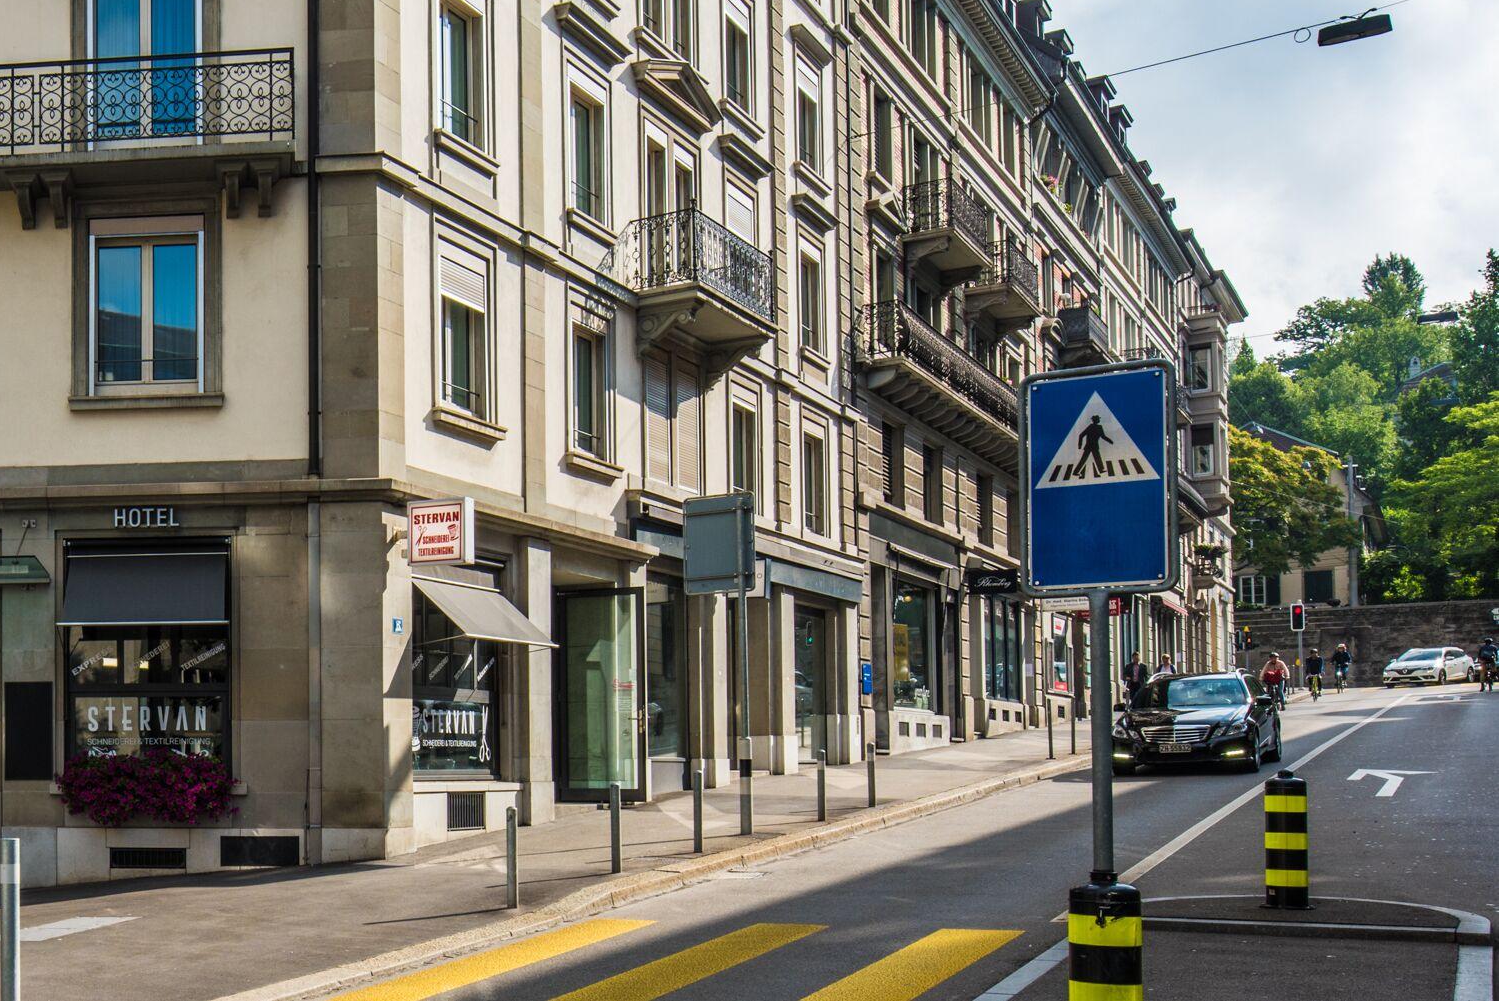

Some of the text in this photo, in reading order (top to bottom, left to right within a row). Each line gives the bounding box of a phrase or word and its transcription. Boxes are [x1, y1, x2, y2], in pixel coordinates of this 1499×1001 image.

[114, 508, 180, 528] HOTEL
[413, 511, 459, 525] STERVAN
[88, 705, 207, 732] STERVAN
[422, 709, 475, 735] STERVAN
